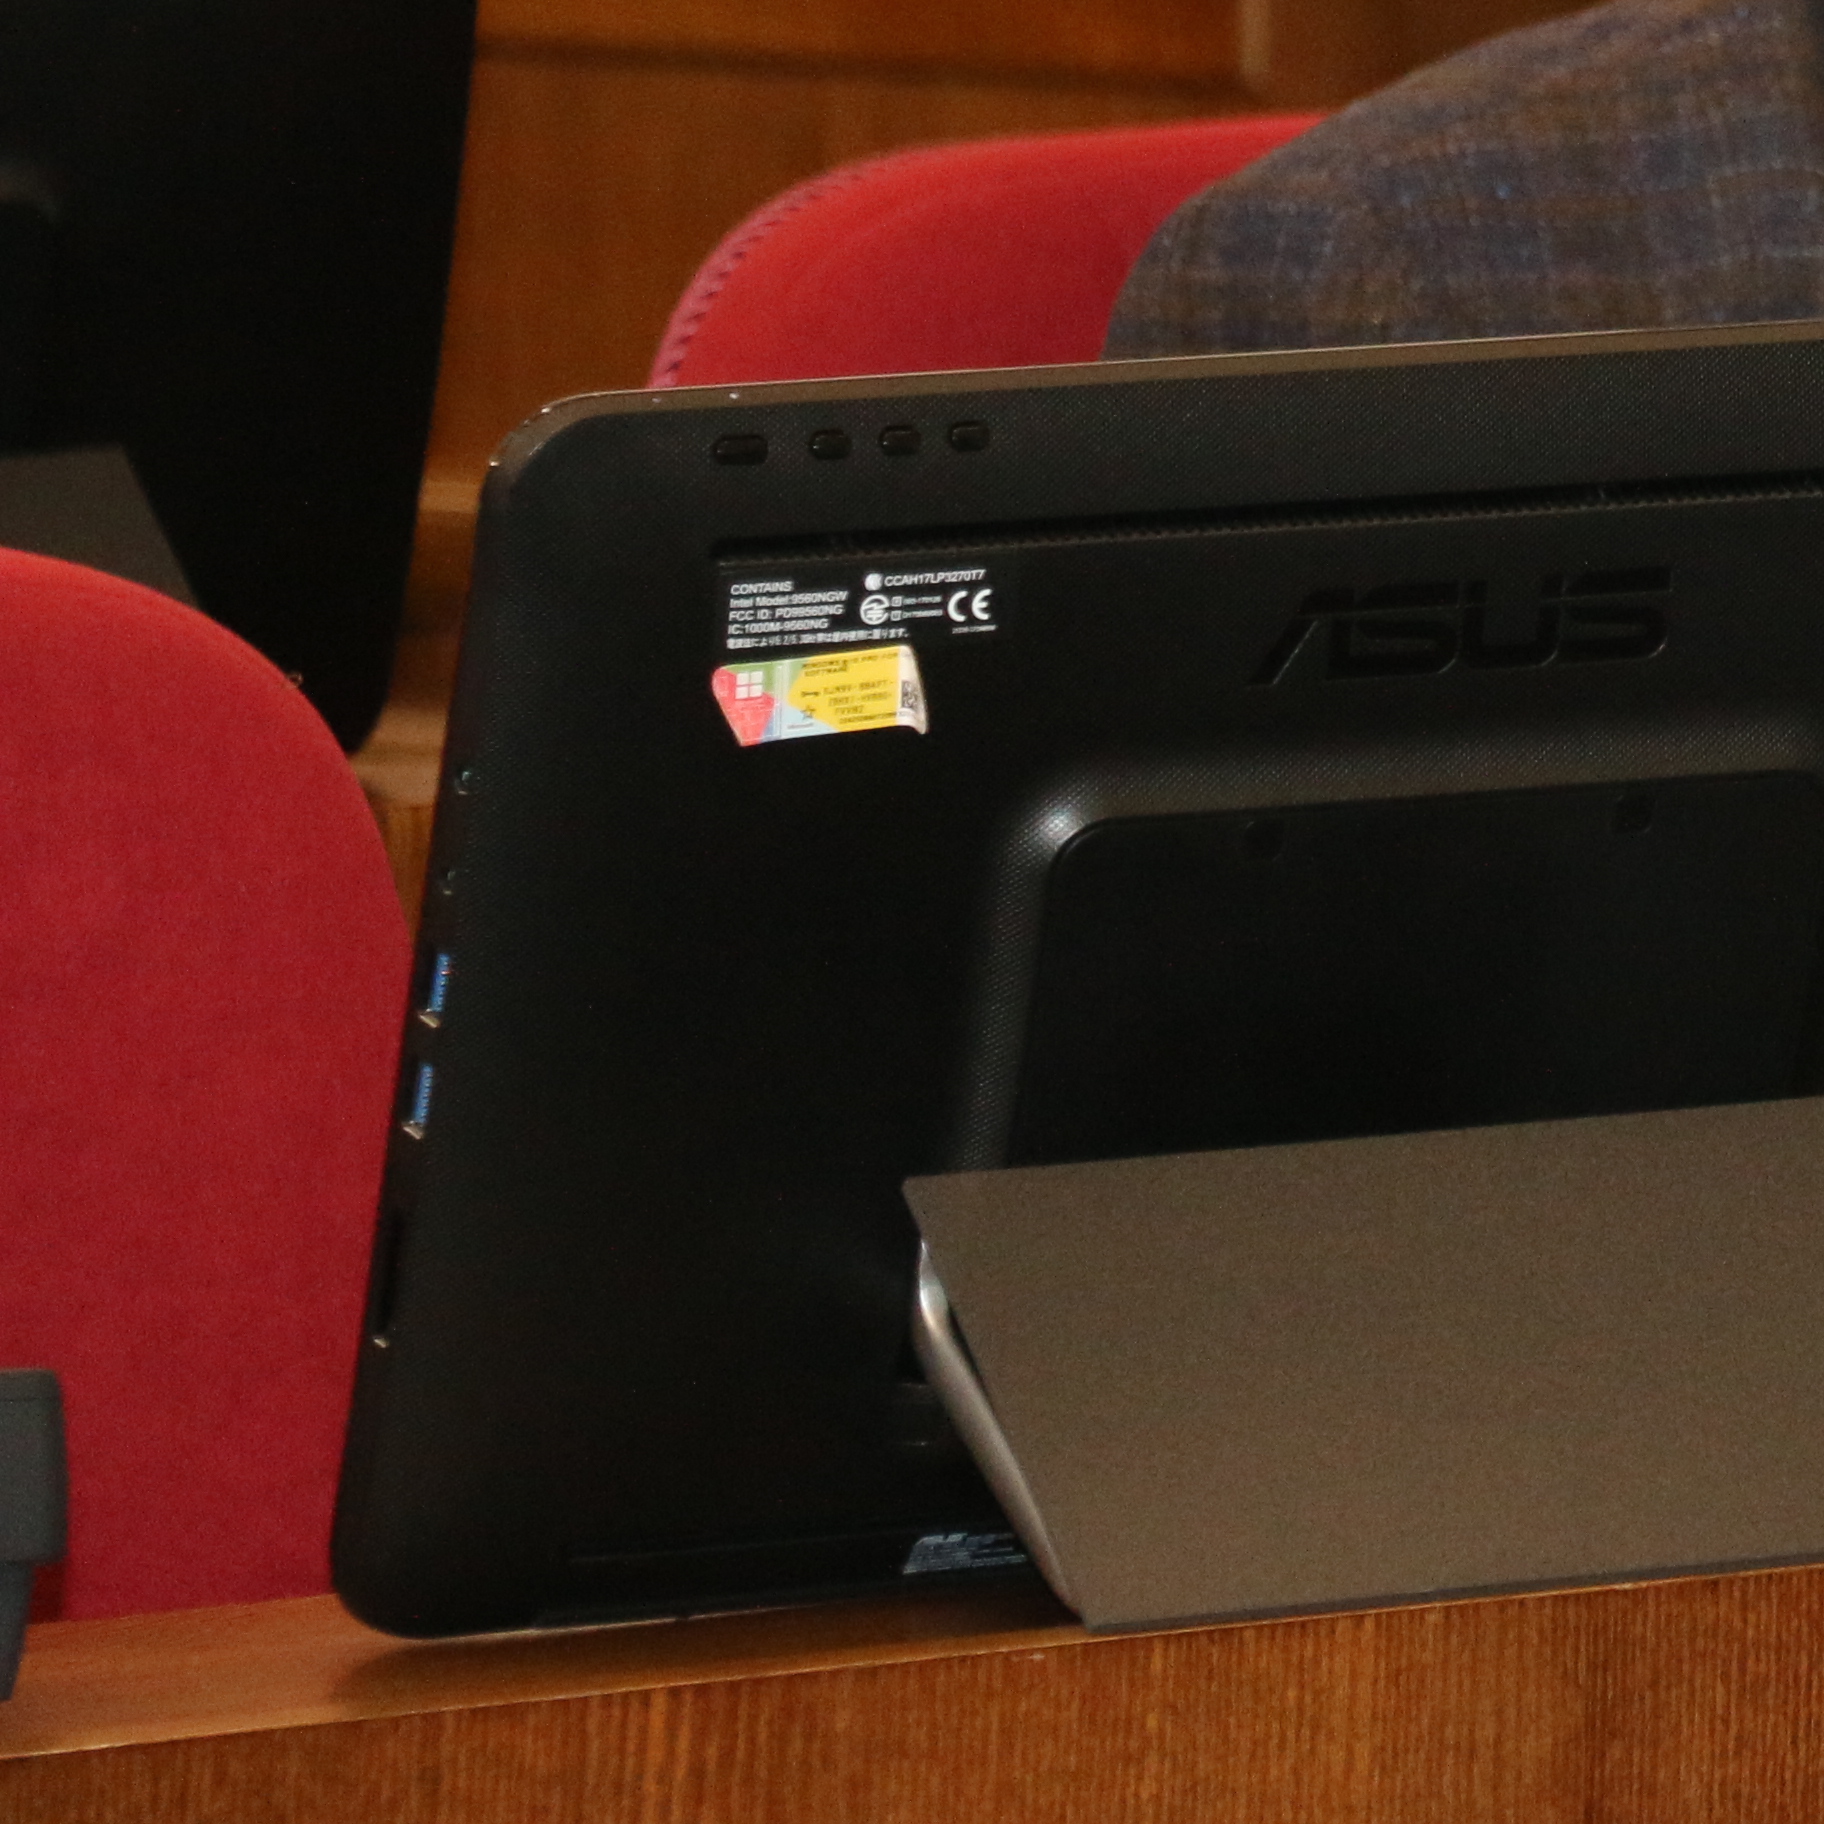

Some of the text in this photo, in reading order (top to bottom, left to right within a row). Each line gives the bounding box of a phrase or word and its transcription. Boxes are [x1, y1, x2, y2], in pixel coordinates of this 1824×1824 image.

[730, 580, 794, 596] CONTAINS
[729, 596, 754, 609] Intel
[728, 609, 755, 622] FCC
[756, 608, 773, 620] ID:
[1246, 565, 1673, 687] ASUS
